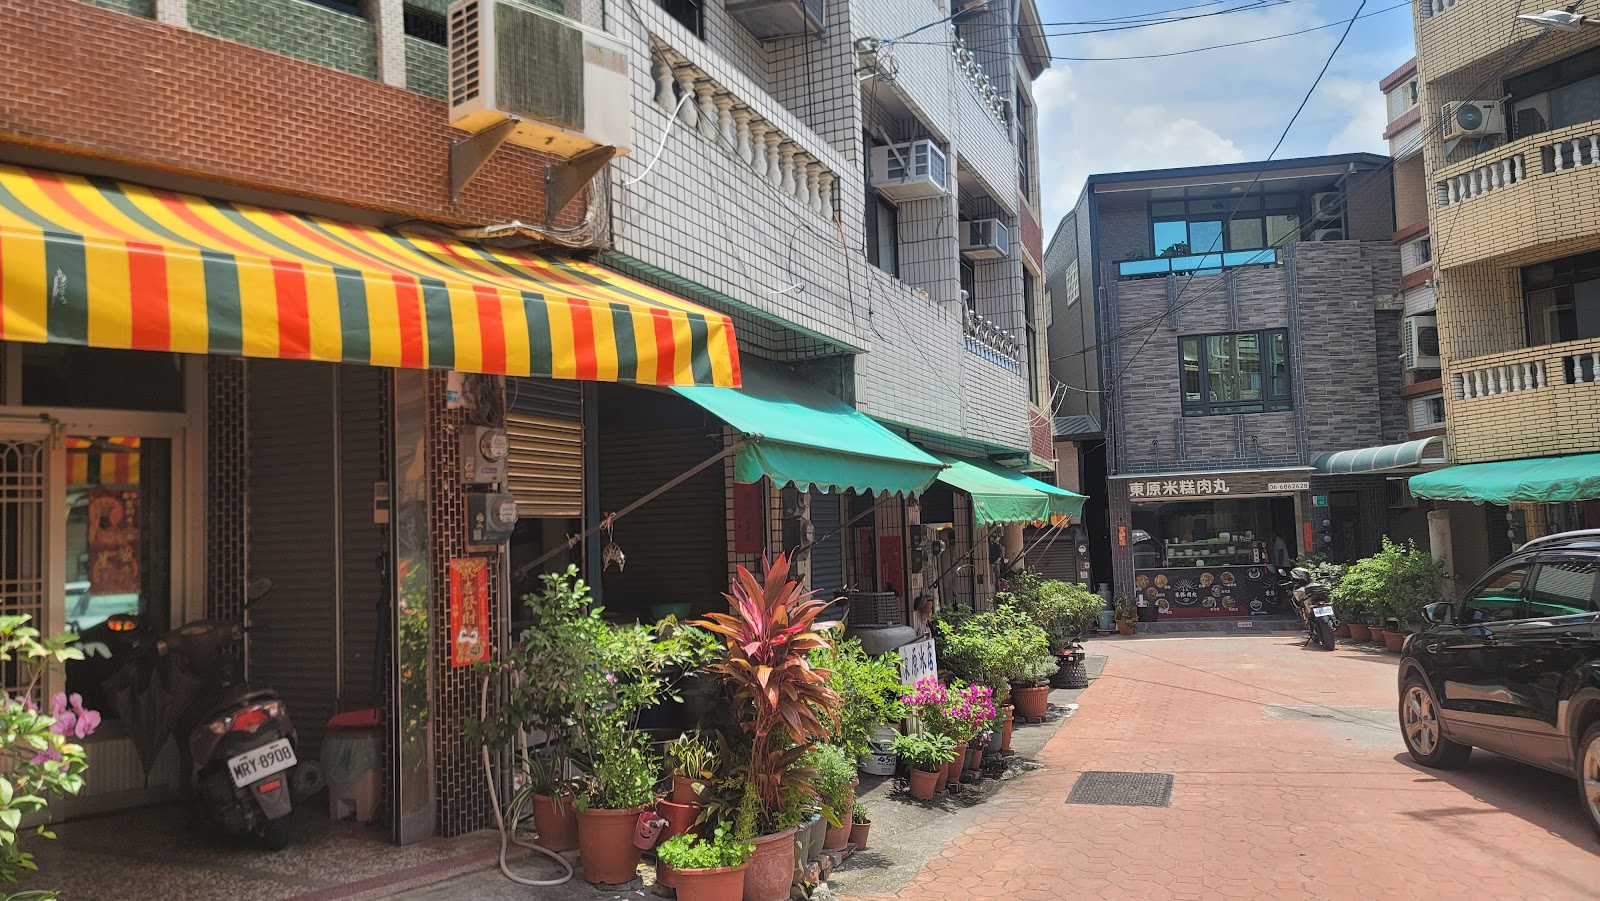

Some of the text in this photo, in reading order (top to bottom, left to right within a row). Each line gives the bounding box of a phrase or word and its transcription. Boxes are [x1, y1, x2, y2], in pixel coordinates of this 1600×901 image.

[1128, 478, 1230, 497] 東原米糕肉丸
[1269, 482, 1308, 490] 06-6862628
[461, 566, 478, 625] 恭喜發財
[233, 746, 292, 780] MRY-8908
